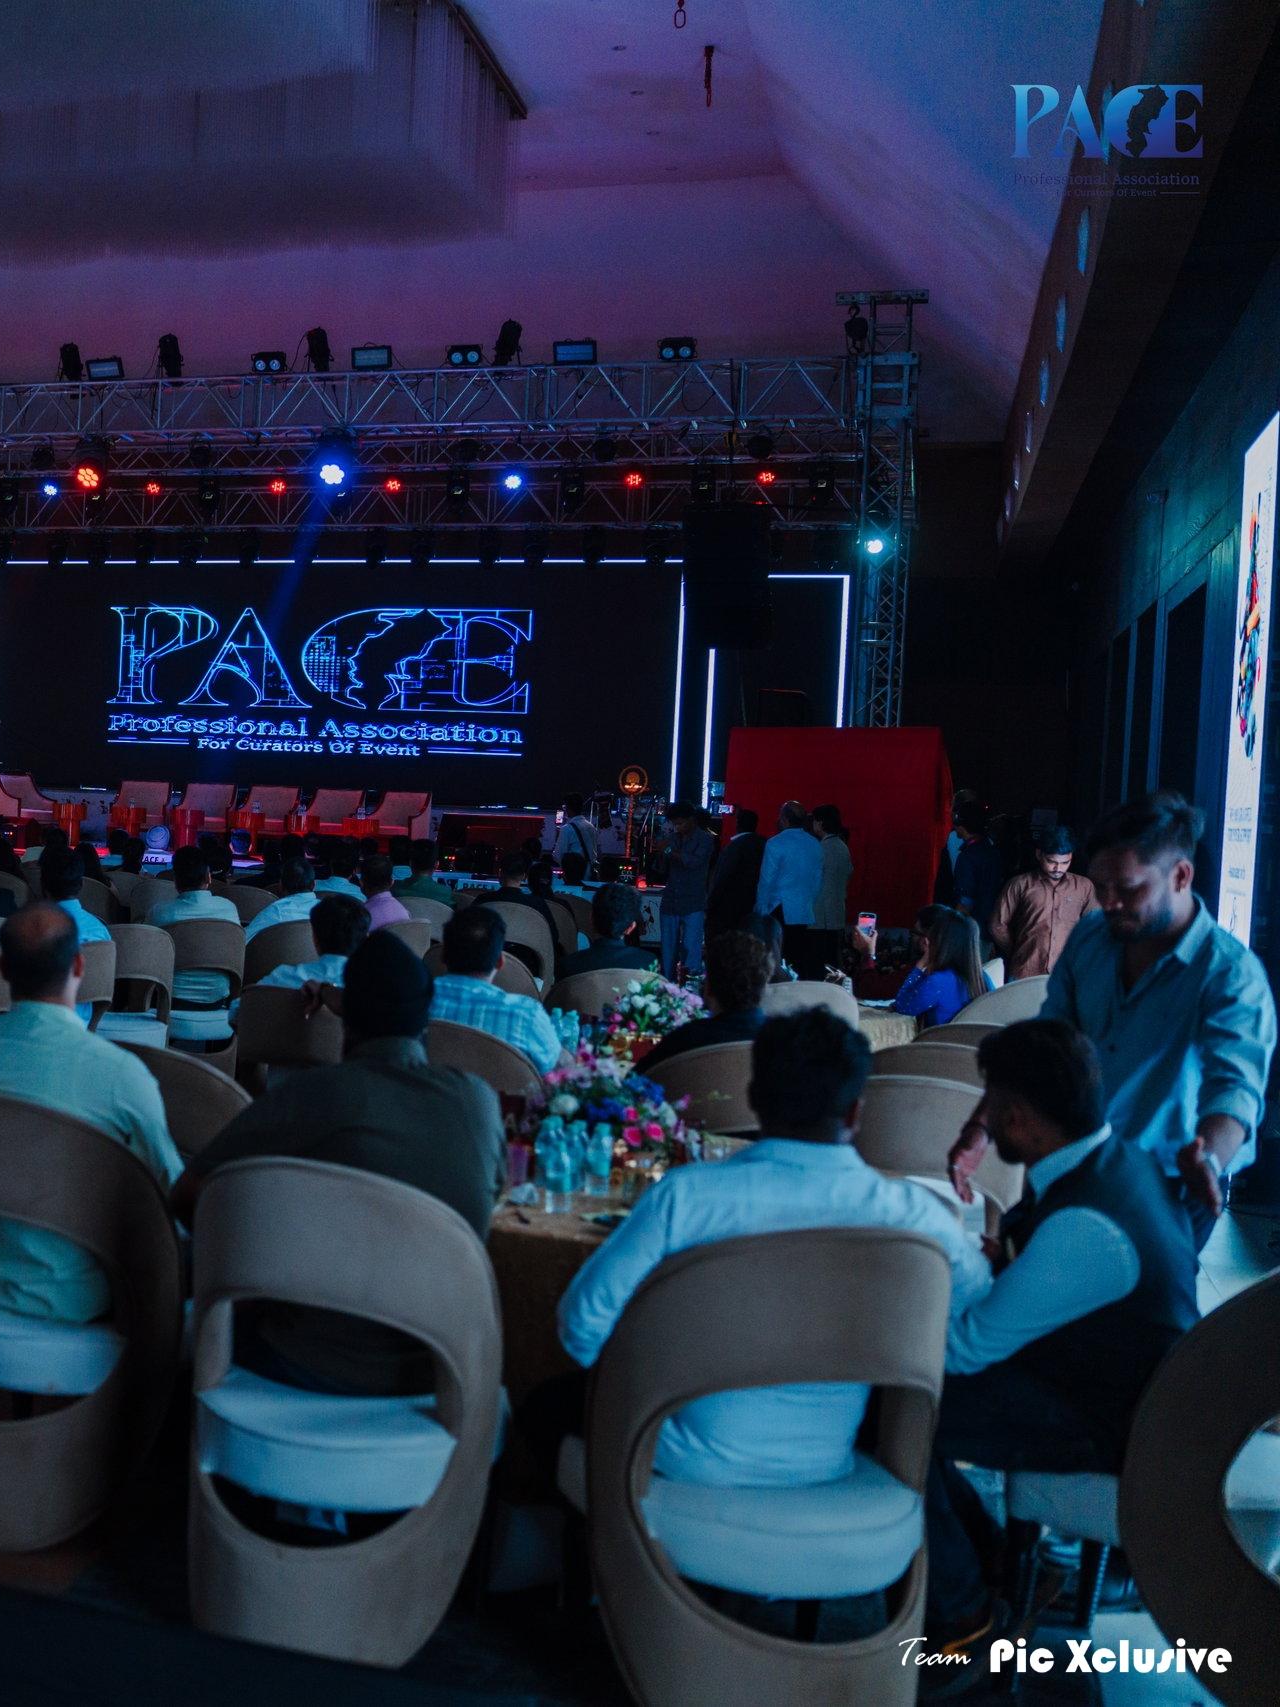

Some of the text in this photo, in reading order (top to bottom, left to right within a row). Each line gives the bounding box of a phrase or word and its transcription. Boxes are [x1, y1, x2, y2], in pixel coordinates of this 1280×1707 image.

[107, 713, 524, 744] Professional Association
[197, 738, 421, 757] For Curators Of Event
